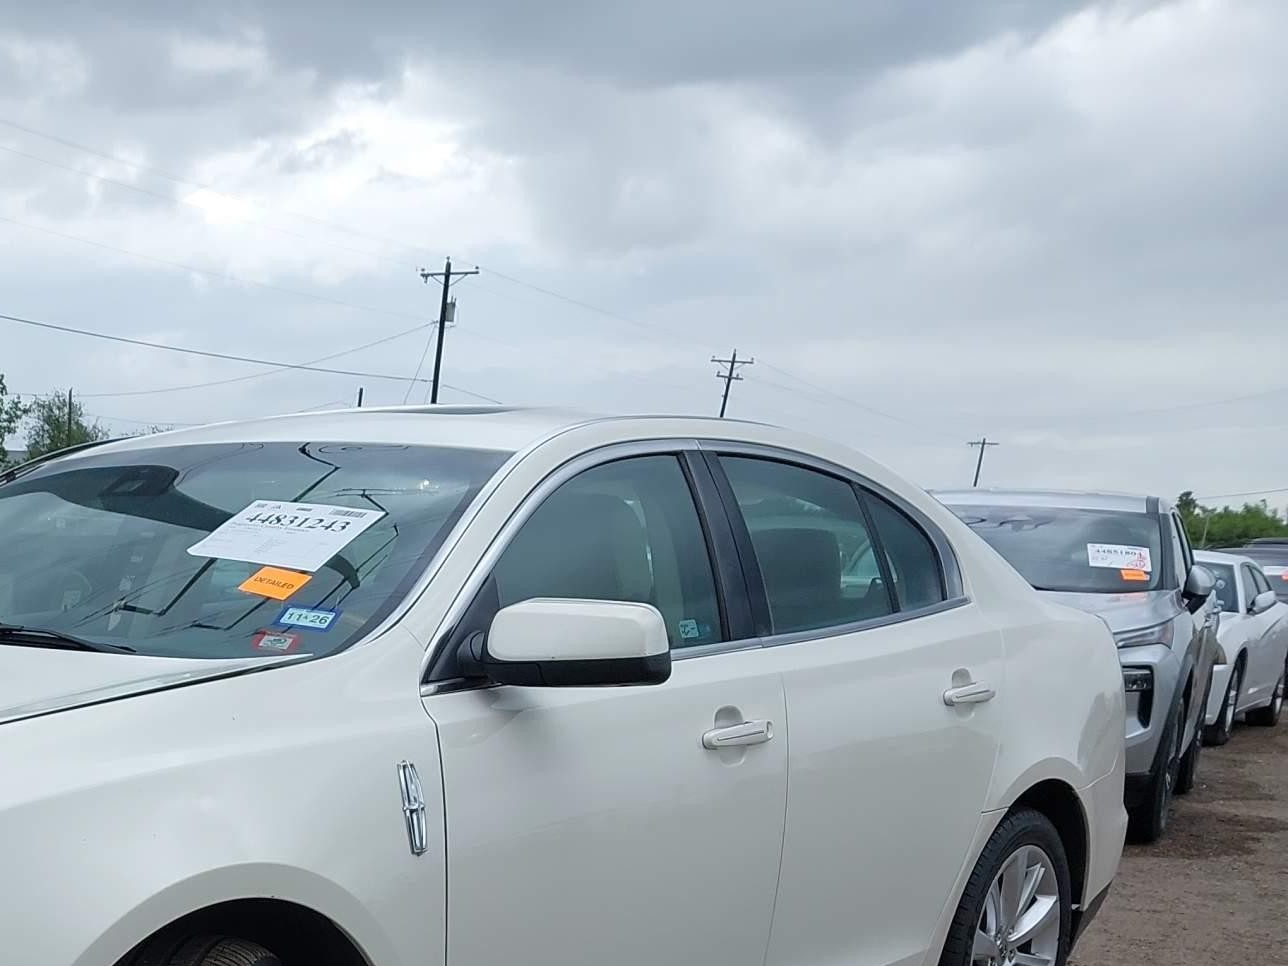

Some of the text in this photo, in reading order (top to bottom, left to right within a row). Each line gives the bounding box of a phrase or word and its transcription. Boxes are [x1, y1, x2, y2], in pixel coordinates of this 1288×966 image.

[246, 512, 351, 532] 44831243
[254, 576, 295, 590] DETAILED
[309, 614, 329, 625] 26
